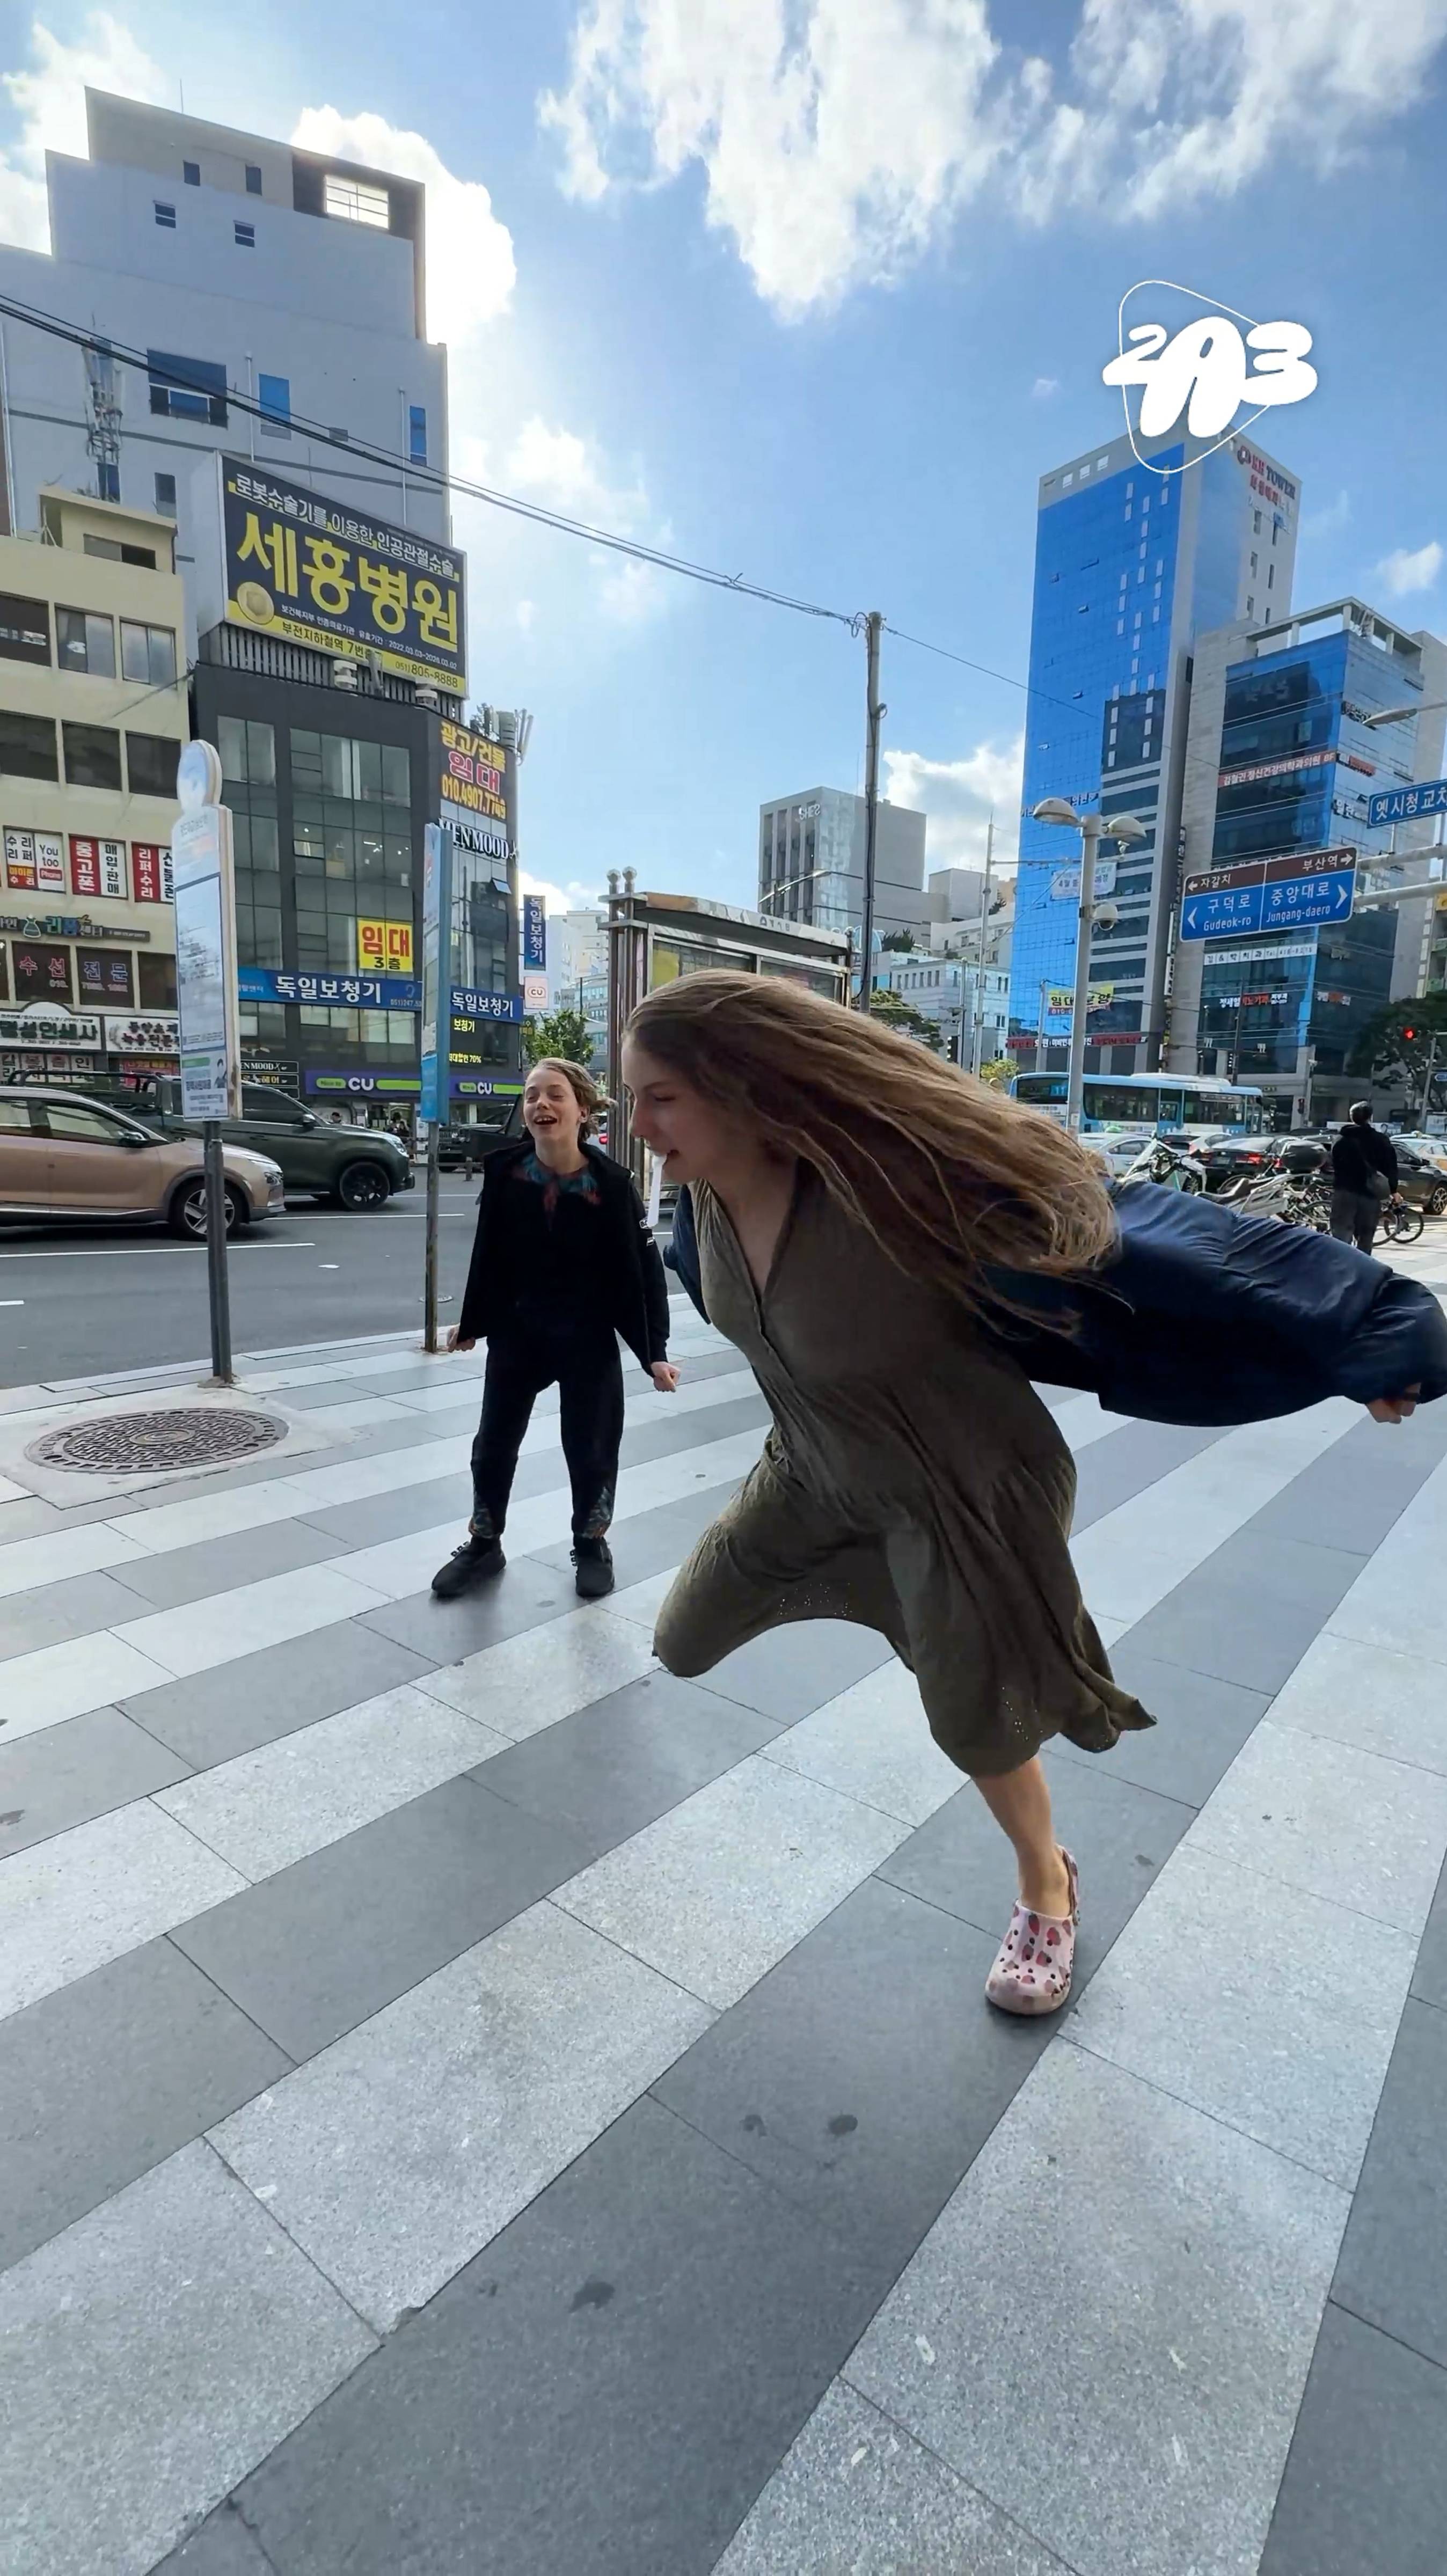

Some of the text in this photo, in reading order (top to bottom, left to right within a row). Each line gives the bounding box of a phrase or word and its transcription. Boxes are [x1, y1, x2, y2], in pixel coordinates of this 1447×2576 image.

[1266, 465, 1296, 500] TOWER
[236, 472, 327, 528] 로봇수술기를
[332, 513, 373, 546] 이용한
[377, 531, 454, 578] 인공관절수술
[236, 511, 458, 654] 세흥병원
[282, 621, 344, 652] 부전지하철역
[441, 721, 506, 773] 광고/건물
[449, 751, 500, 795] 임대
[39, 844, 59, 856] You
[472, 829, 509, 860] MOOD
[42, 857, 59, 867] too
[76, 841, 94, 891] 중고폰
[1302, 854, 1338, 871] 부산역
[1200, 873, 1231, 888] 자갈치
[1270, 881, 1329, 906] 중앙대로
[1207, 894, 1251, 913] 구덕로
[1266, 904, 1331, 923] Jungang-daero
[530, 897, 543, 963] 독일보청기
[1203, 916, 1252, 931] Gudeok-ro
[362, 926, 410, 957] 임대
[19, 956, 128, 983] 수선 전문
[374, 957, 400, 970] 3층
[275, 975, 381, 1004] 독일보청기
[451, 991, 513, 1018] 독일보청기
[454, 1018, 475, 1033] 보청기
[348, 1077, 374, 1091] CU
[477, 1081, 492, 1095] CU
